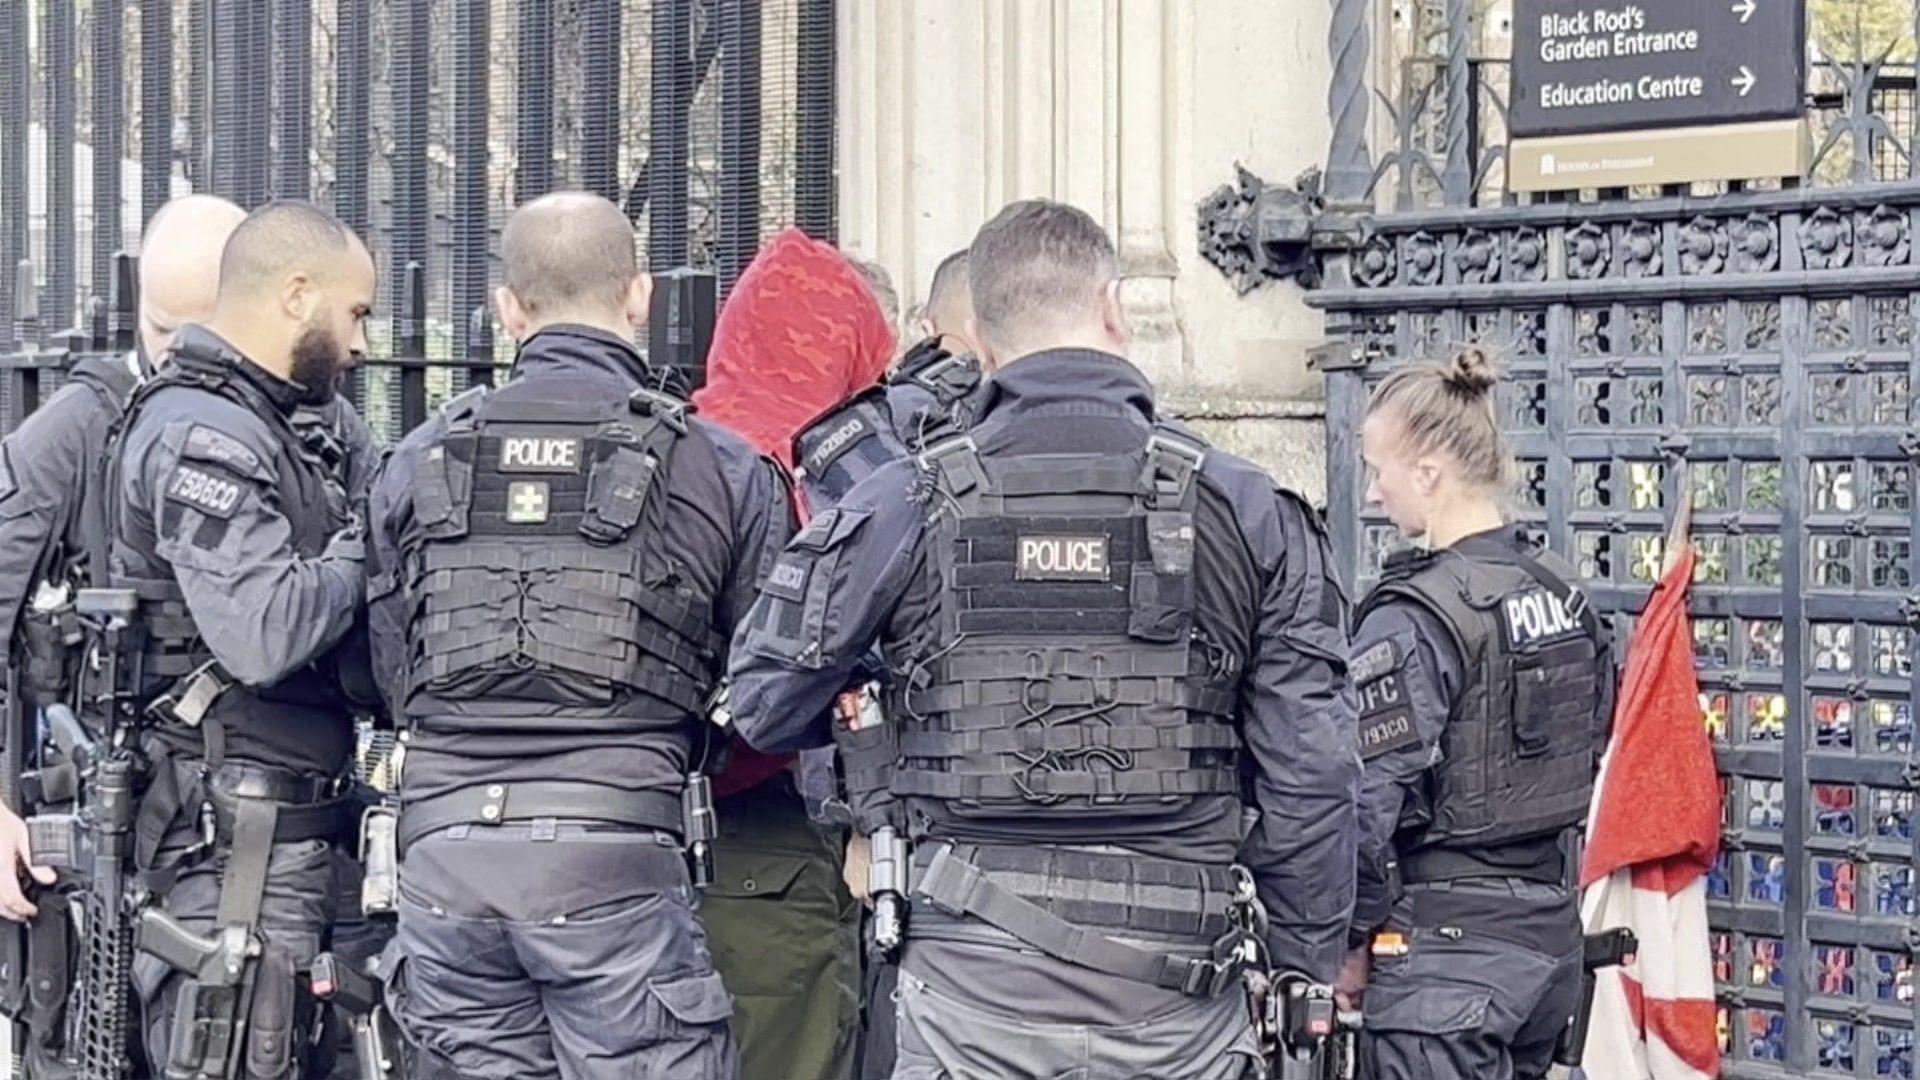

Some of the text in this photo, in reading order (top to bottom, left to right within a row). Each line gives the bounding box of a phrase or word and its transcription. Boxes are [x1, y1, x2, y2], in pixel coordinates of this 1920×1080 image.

[1541, 5, 1645, 38] Black Rod's
[1540, 29, 1698, 62] Garden Entrance
[1540, 74, 1703, 108] Education Centre
[503, 438, 576, 467] POLICE
[1022, 540, 1103, 572] POLICE
[1507, 591, 1582, 643] POLIC
